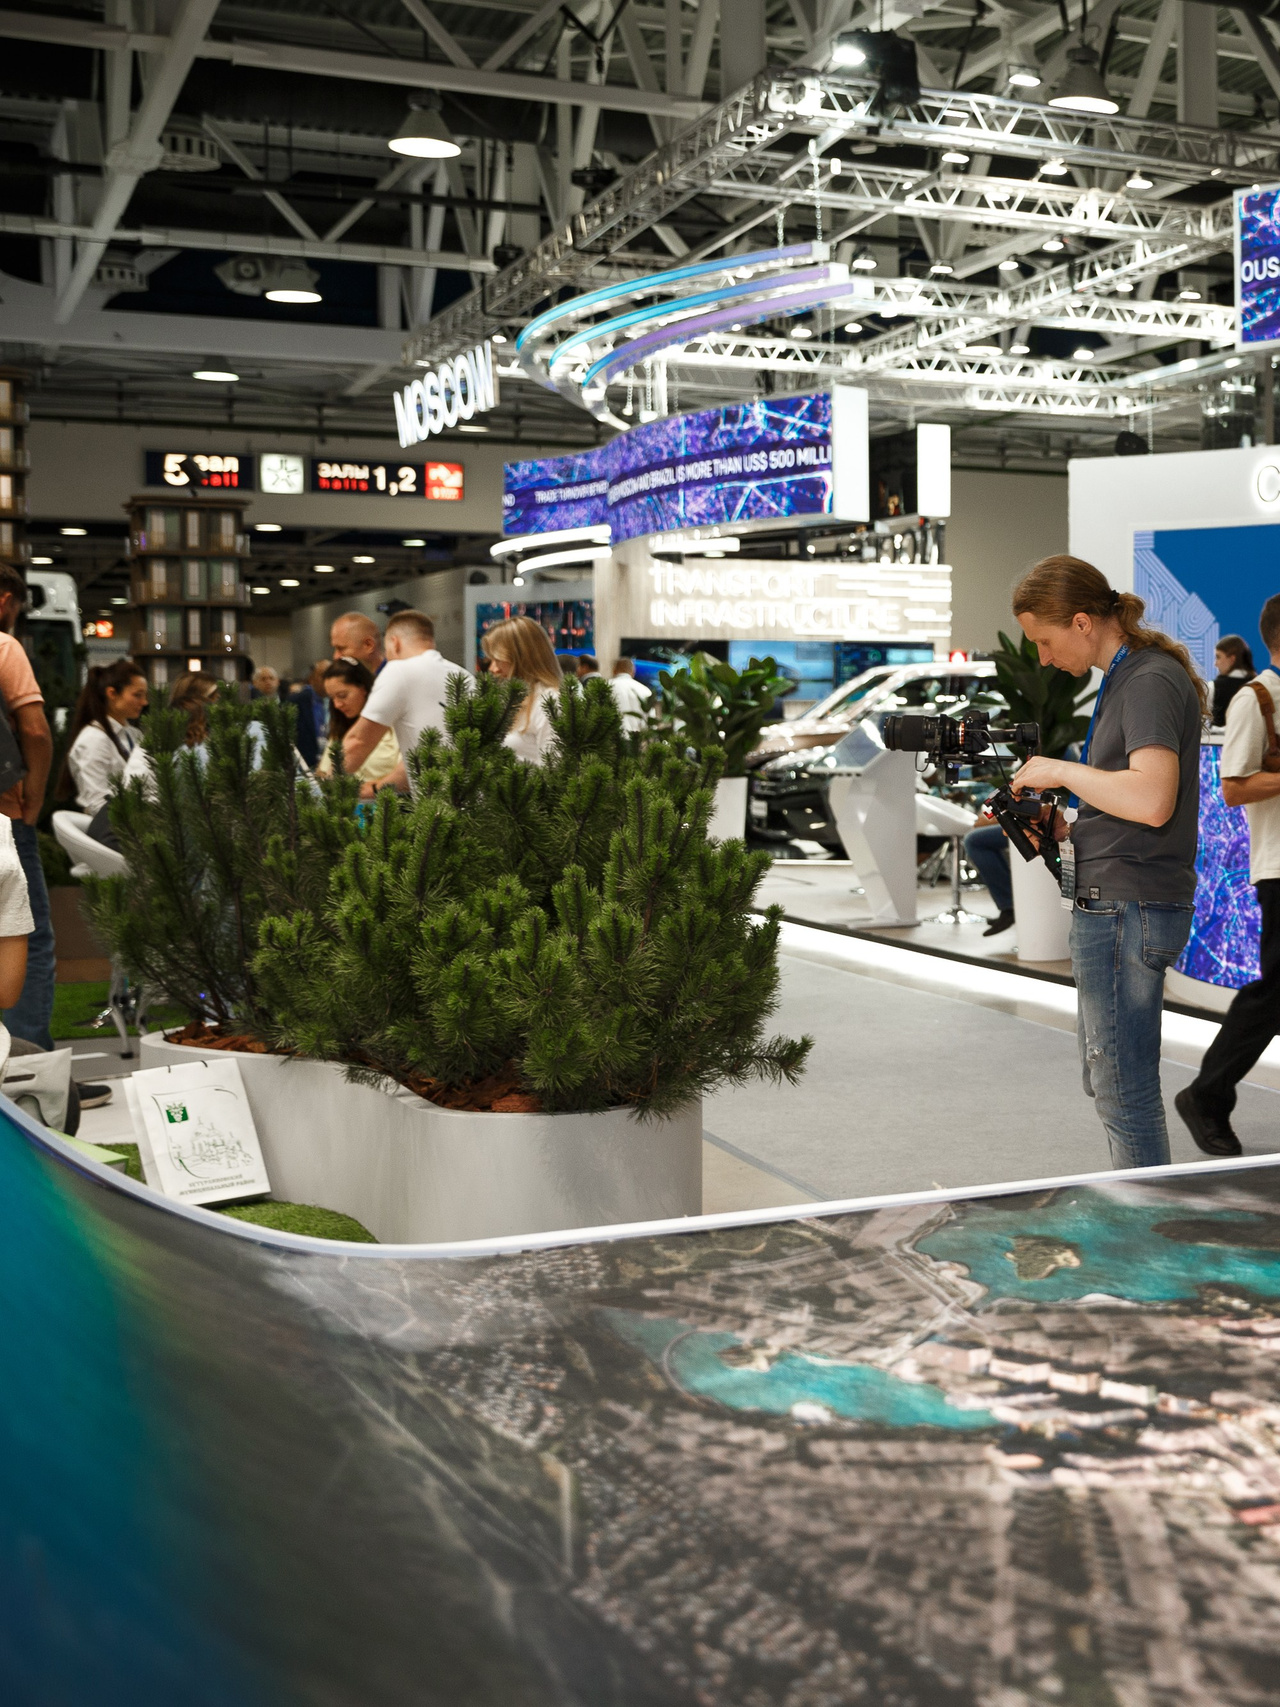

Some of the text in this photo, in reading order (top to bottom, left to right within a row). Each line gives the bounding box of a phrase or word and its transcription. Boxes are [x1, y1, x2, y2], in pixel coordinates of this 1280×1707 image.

[393, 339, 496, 449] MOSCOW
[163, 453, 190, 487] 5
[200, 472, 239, 487] all
[318, 477, 369, 492] halls
[371, 465, 417, 497] 1,2
[650, 466, 677, 489] BRAZIL
[675, 463, 686, 483] IS
[686, 460, 713, 482] MORE
[714, 456, 743, 477] THAN
[743, 450, 768, 474] US$
[768, 448, 795, 469] 500
[649, 561, 818, 598] TRANSPORT
[649, 600, 904, 630] INFRASTRUCTURE
